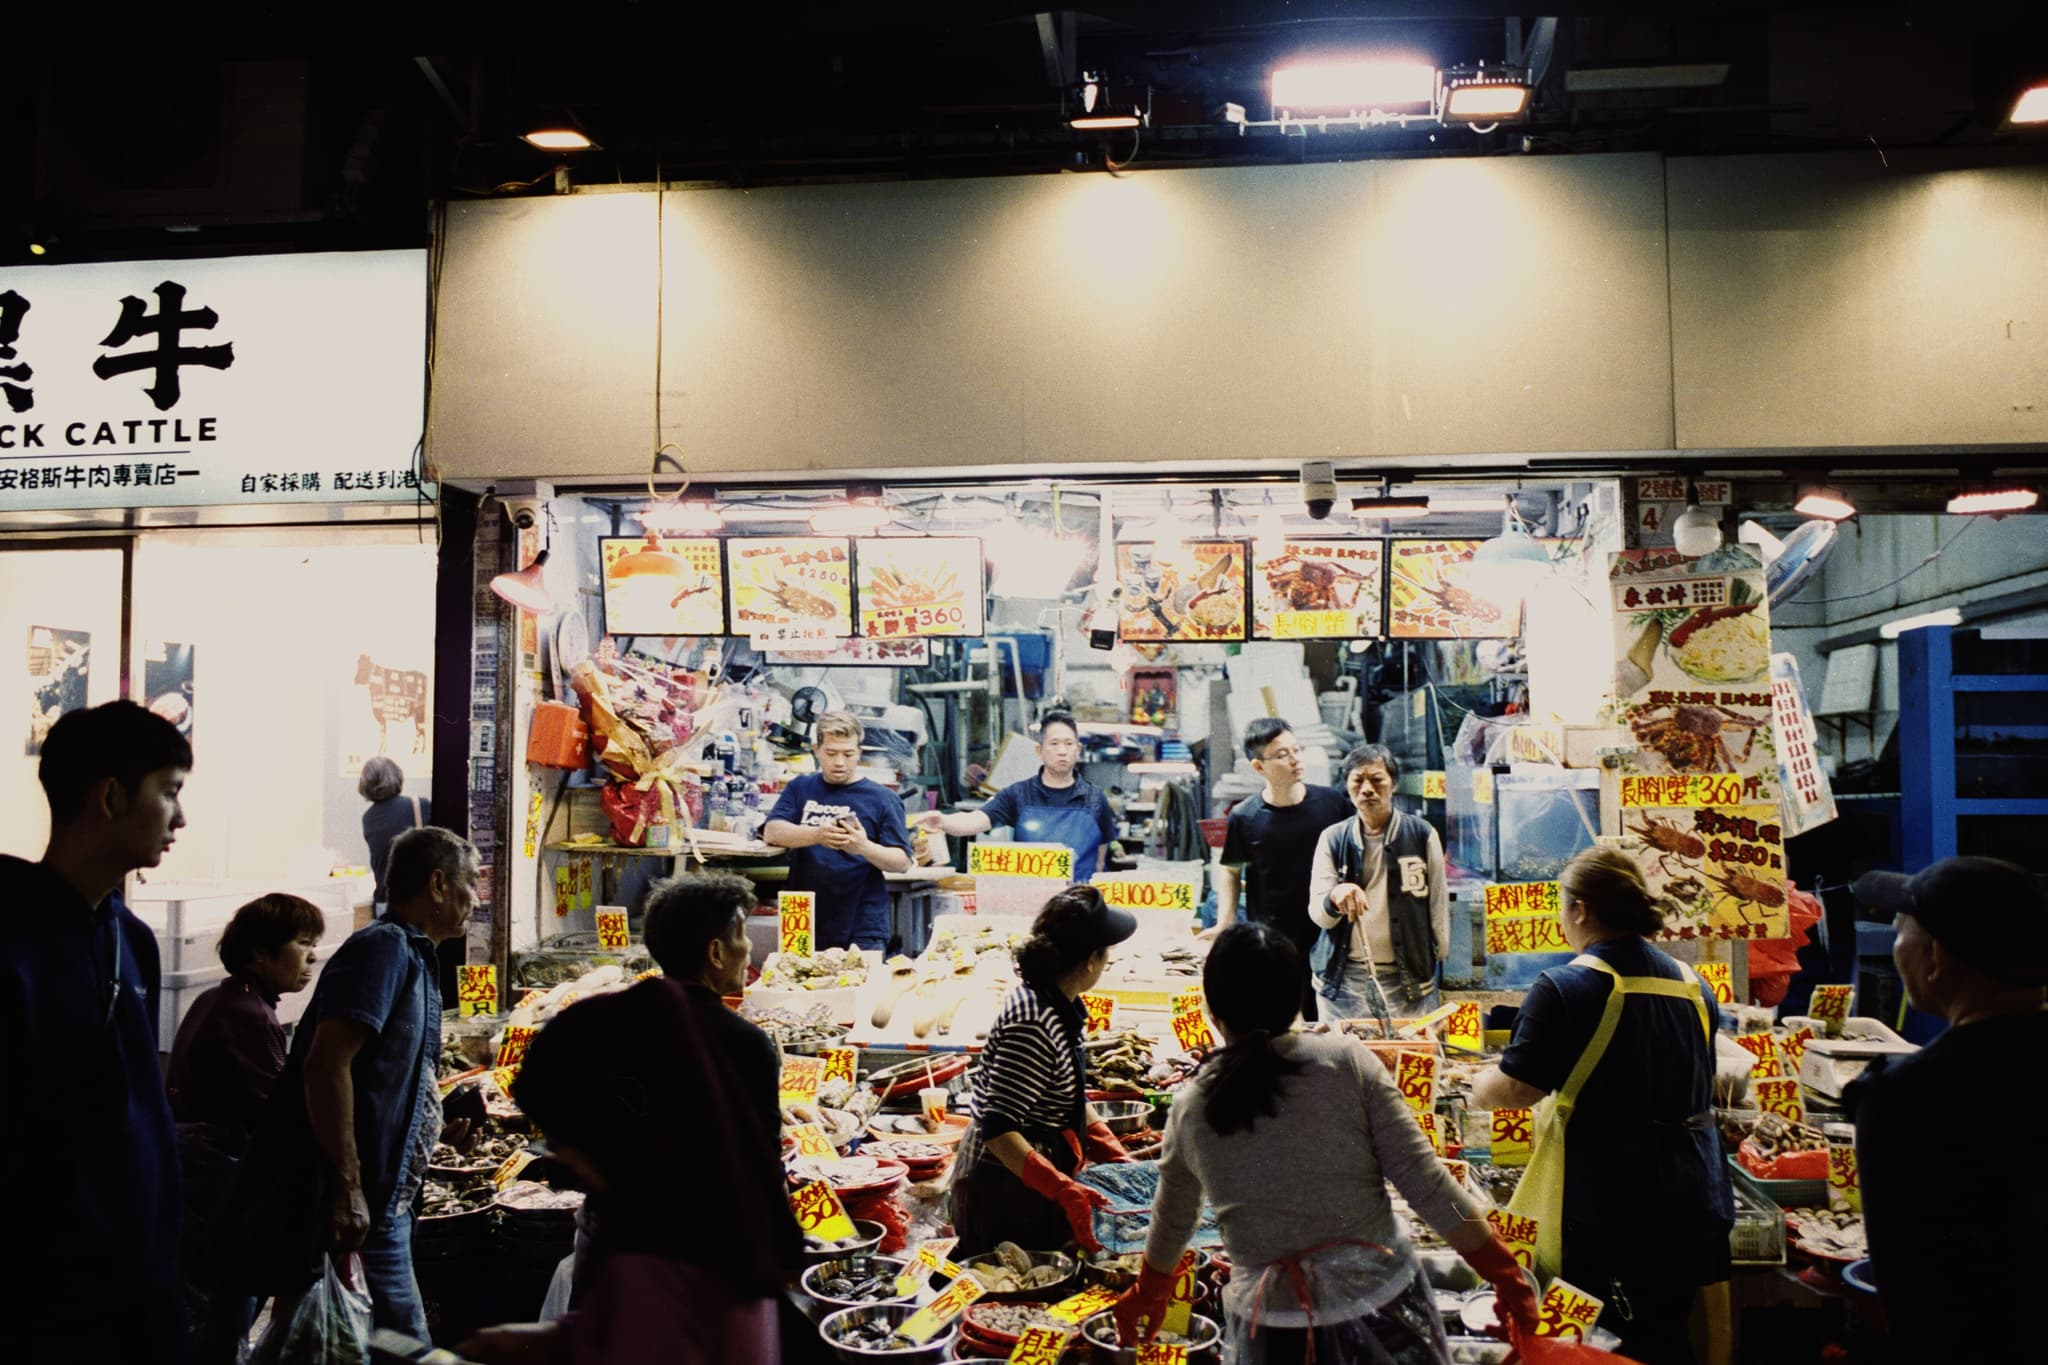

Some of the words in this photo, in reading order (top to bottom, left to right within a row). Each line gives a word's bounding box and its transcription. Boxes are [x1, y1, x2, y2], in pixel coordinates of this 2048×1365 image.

[0, 280, 235, 413] 牛
[65, 418, 217, 446] CATTLE
[241, 472, 321, 493] 自家採購
[333, 469, 419, 490] 配送到港
[1700, 776, 1741, 804] 360
[1708, 838, 1768, 866] $250
[801, 1198, 839, 1230] 50
